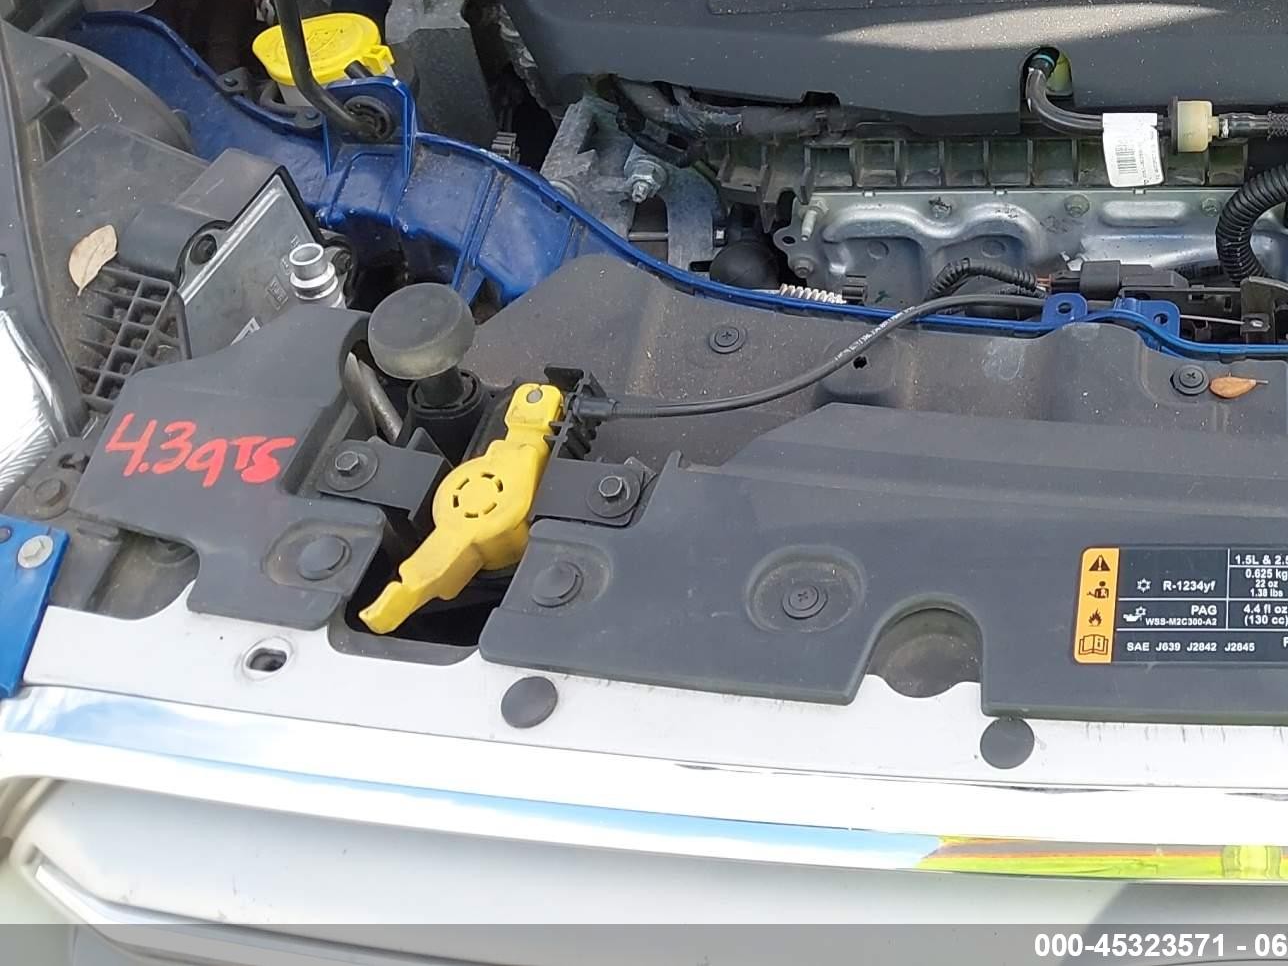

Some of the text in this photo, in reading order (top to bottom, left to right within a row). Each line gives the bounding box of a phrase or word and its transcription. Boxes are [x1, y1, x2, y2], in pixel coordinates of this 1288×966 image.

[1235, 554, 1259, 565] 1.5L
[1262, 554, 1271, 565] &
[1245, 568, 1288, 581] 0.625 kg
[1163, 581, 1216, 592] R-1234yf
[1255, 579, 1279, 588] 22 oz
[1250, 588, 1283, 597] 1.38 lbs
[1190, 605, 1218, 616] PAG
[1243, 603, 1288, 614] 4.4 fl oz
[1244, 615, 1288, 626] (130 cc)
[1126, 642, 1255, 652] SAE J639 J2842 J2845
